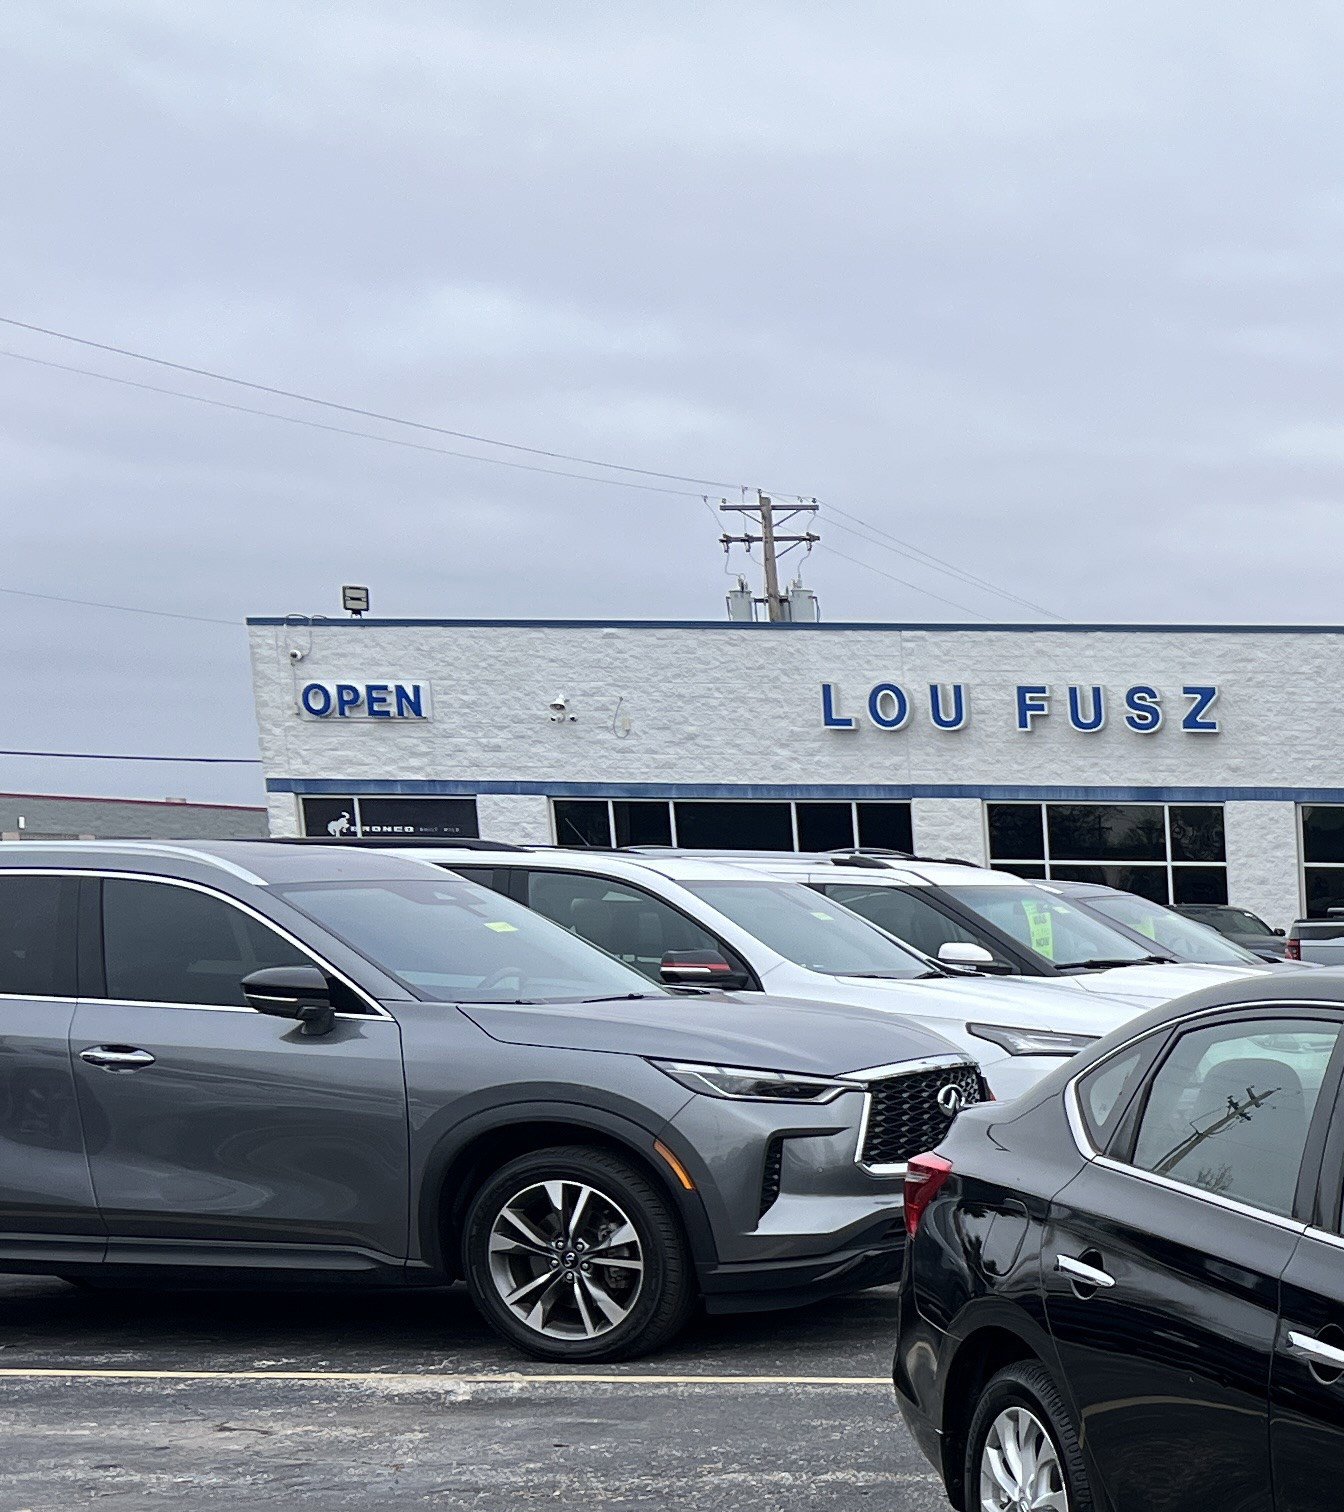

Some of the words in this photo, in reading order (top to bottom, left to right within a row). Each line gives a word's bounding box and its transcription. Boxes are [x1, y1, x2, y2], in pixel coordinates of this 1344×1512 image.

[302, 682, 425, 720] OPEN
[821, 682, 967, 731] LOU
[1016, 684, 1221, 734] FUSZ
